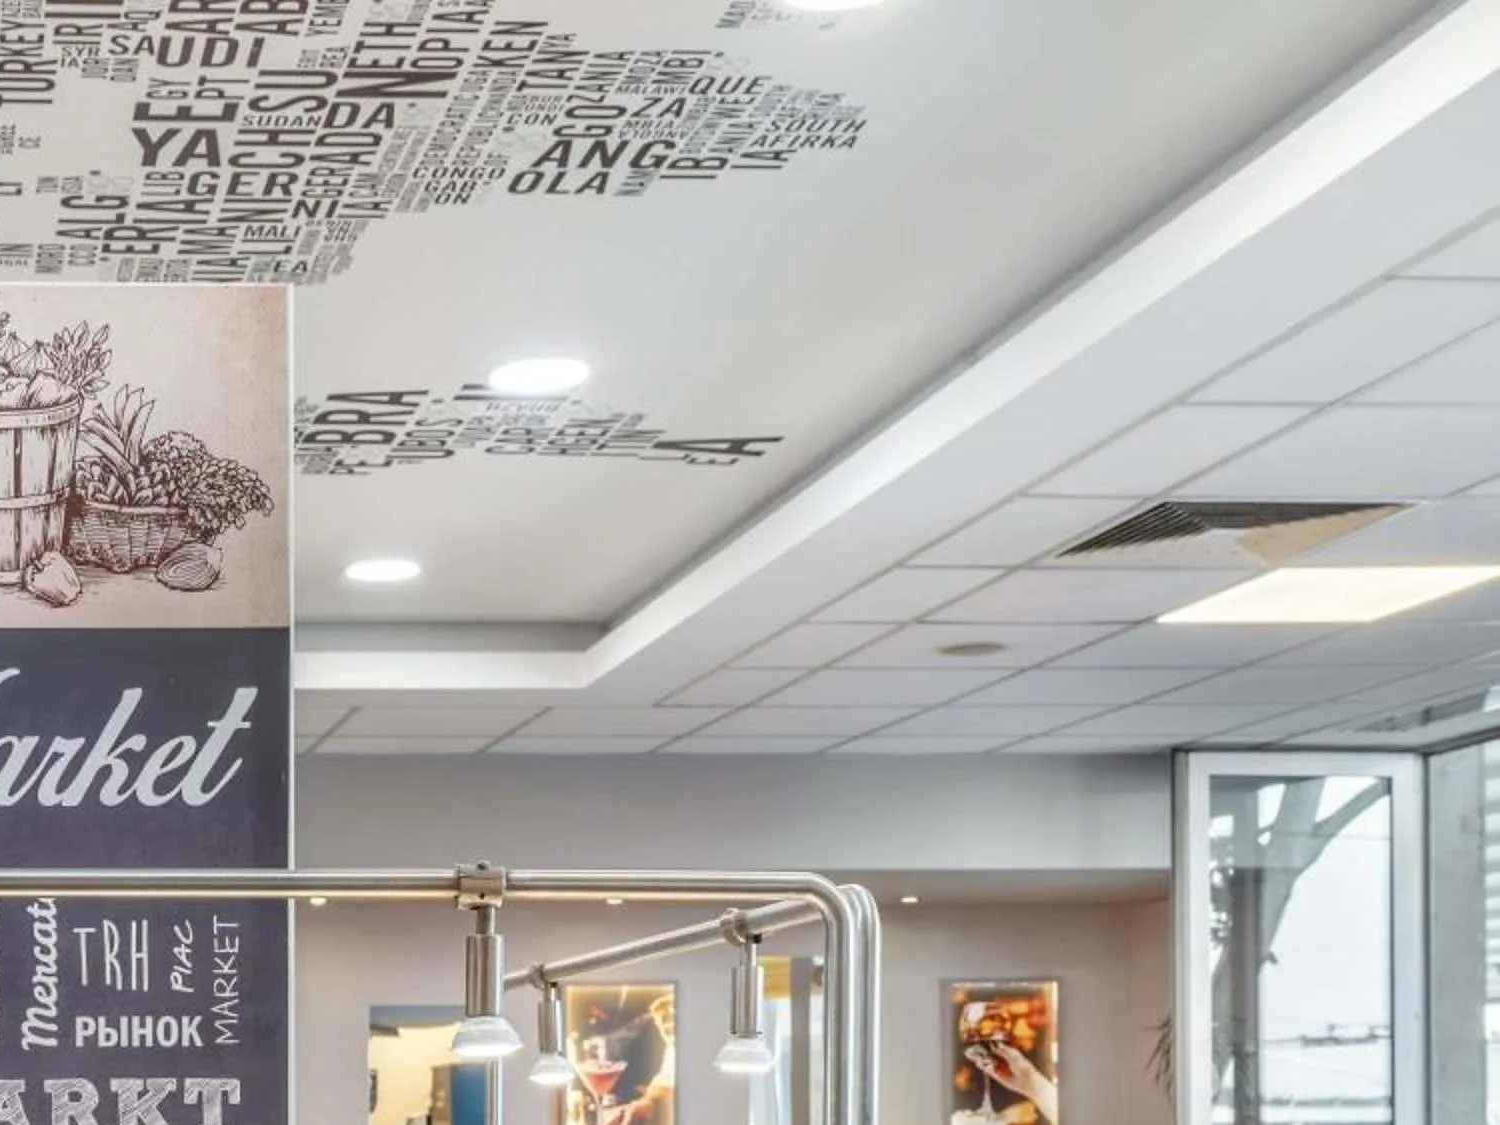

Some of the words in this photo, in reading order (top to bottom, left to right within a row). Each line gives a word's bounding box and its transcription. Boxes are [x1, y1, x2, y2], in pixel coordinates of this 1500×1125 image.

[765, 119, 868, 134] SOUTH
[531, 140, 678, 169] ANG
[506, 171, 612, 196] OLA
[72, 918, 149, 992] TRH
[209, 913, 241, 1045] MARKET
[74, 1015, 204, 1048] РЫНОК
